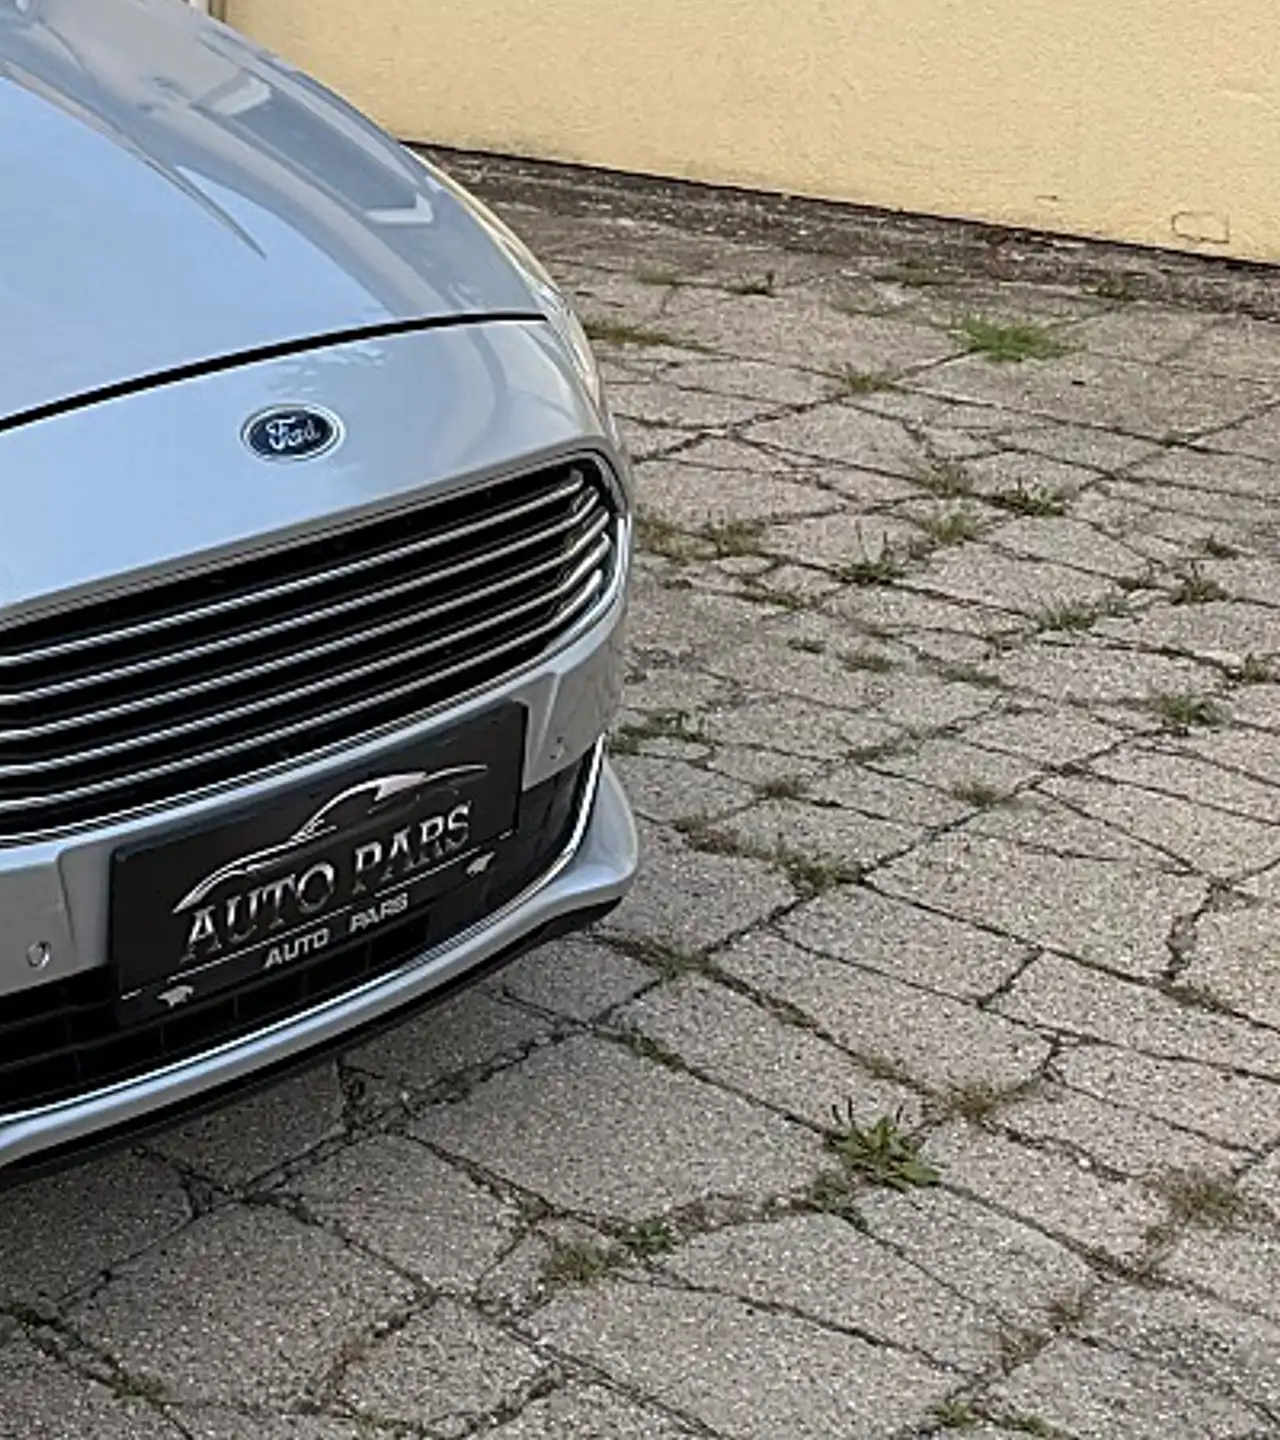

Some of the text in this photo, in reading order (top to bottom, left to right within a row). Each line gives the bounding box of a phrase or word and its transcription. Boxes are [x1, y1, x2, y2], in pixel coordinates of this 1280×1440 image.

[265, 415, 321, 450] Ford
[179, 799, 473, 964] AUTO PARS
[263, 892, 410, 971] AUTO PARS
